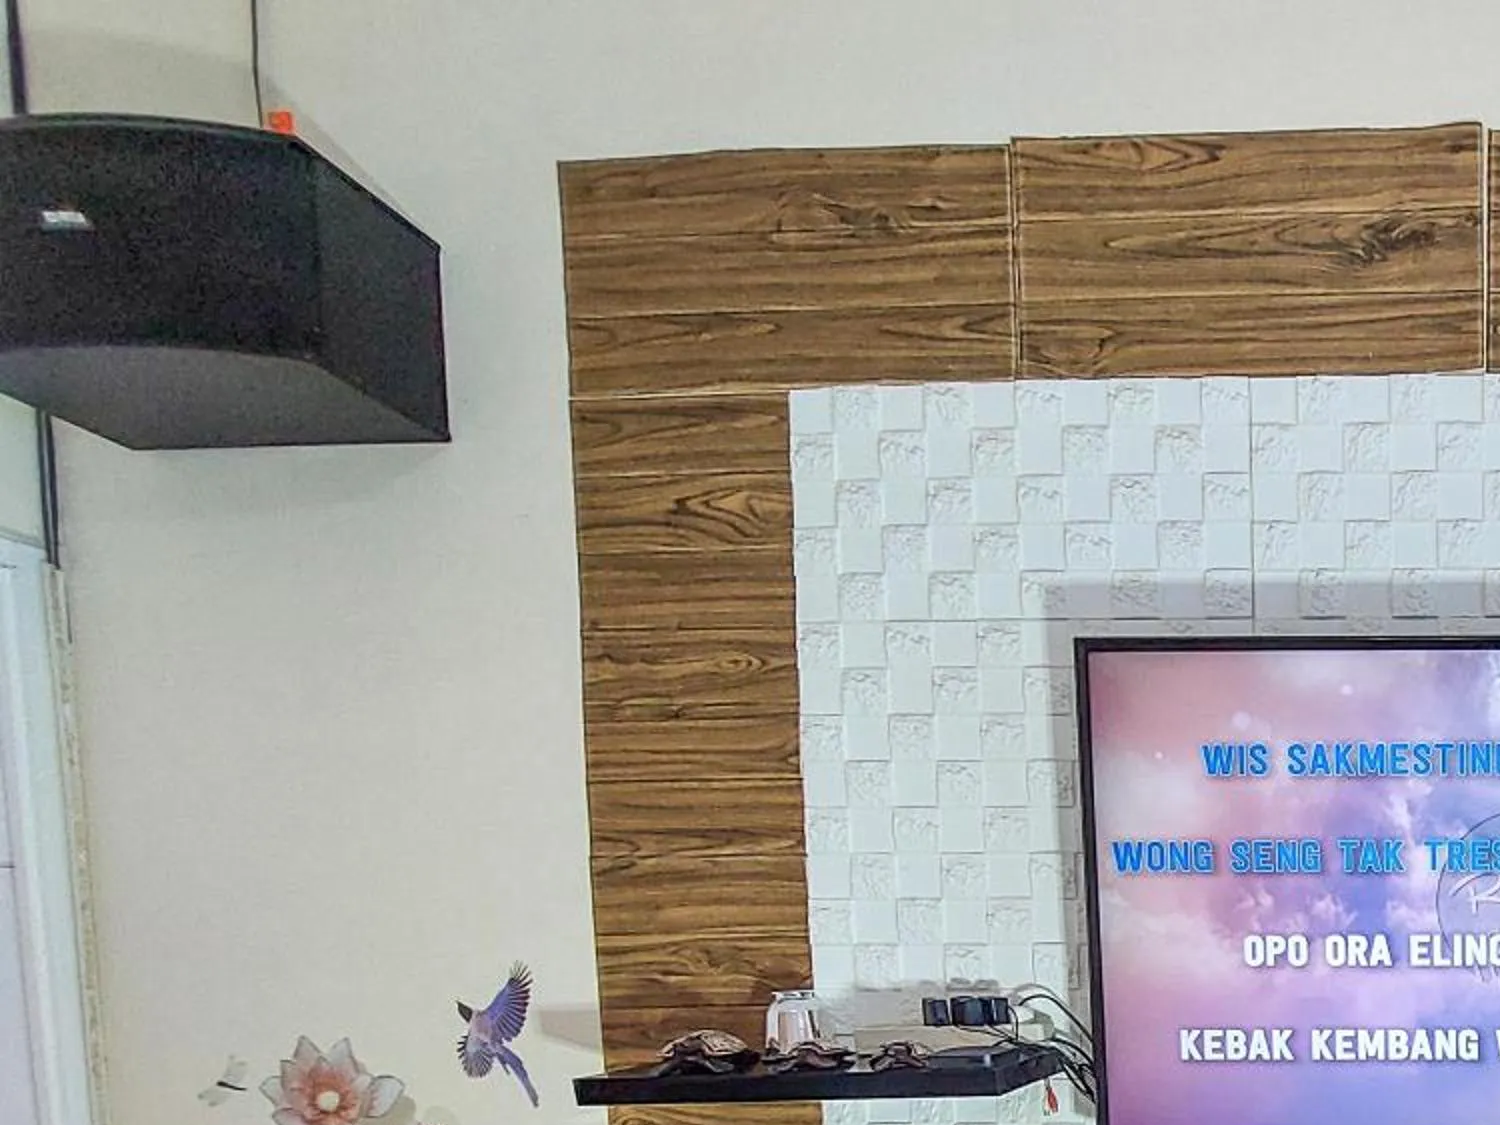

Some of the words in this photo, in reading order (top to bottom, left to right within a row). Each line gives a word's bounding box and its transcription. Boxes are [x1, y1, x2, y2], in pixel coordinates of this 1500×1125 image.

[1202, 741, 1269, 778] WIS
[1111, 839, 1214, 874] WONG
[1230, 839, 1322, 874] SENG
[1338, 838, 1406, 874] TAK
[1242, 933, 1309, 968] OPO
[1324, 933, 1393, 968] ORA
[1178, 1027, 1295, 1062] KEBAK
[1310, 1027, 1480, 1062] KEMBANG
